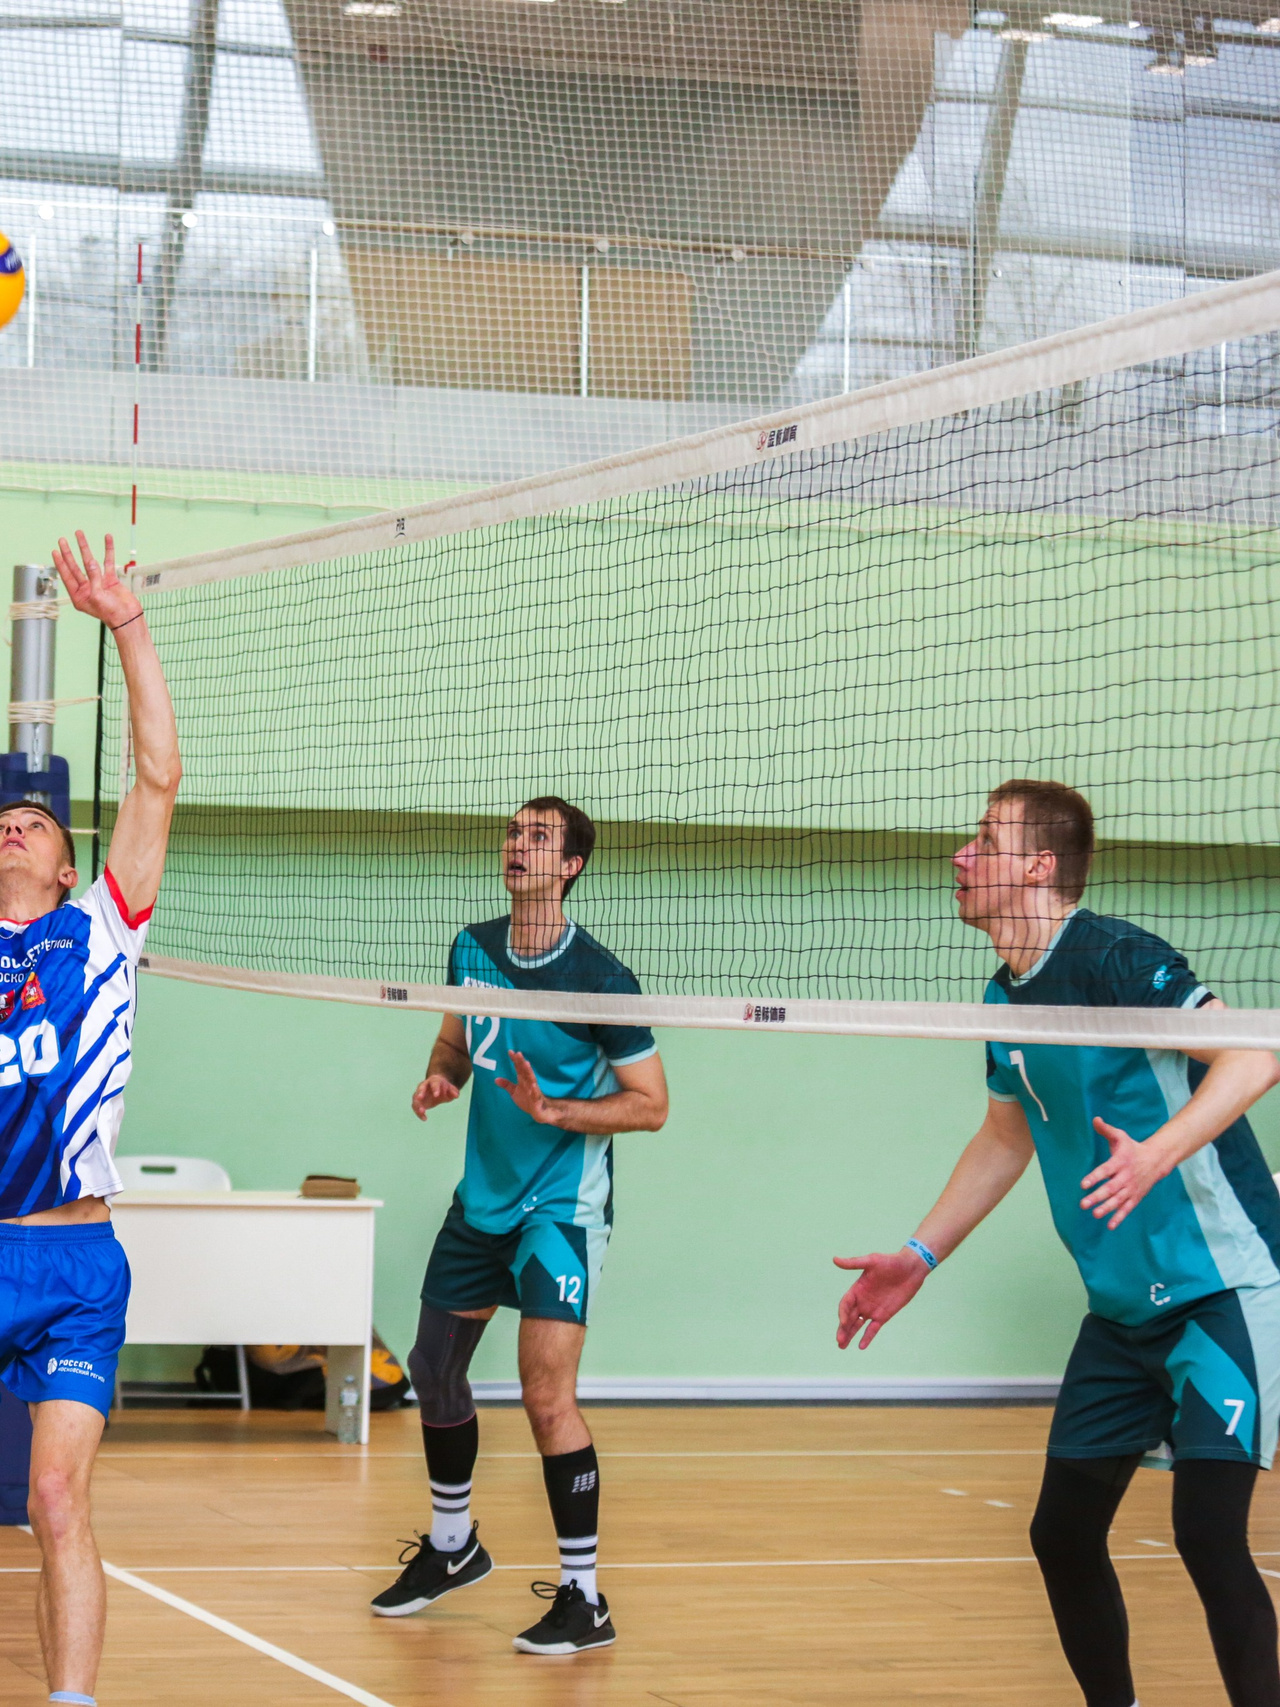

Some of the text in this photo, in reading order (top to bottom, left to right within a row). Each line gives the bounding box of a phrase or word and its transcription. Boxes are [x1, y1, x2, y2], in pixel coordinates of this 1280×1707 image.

[1009, 1050, 1049, 1122] 7
[555, 1274, 581, 1304] 12
[59, 1359, 94, 1371] РОССЕТИ
[1223, 1398, 1245, 1436] 7
